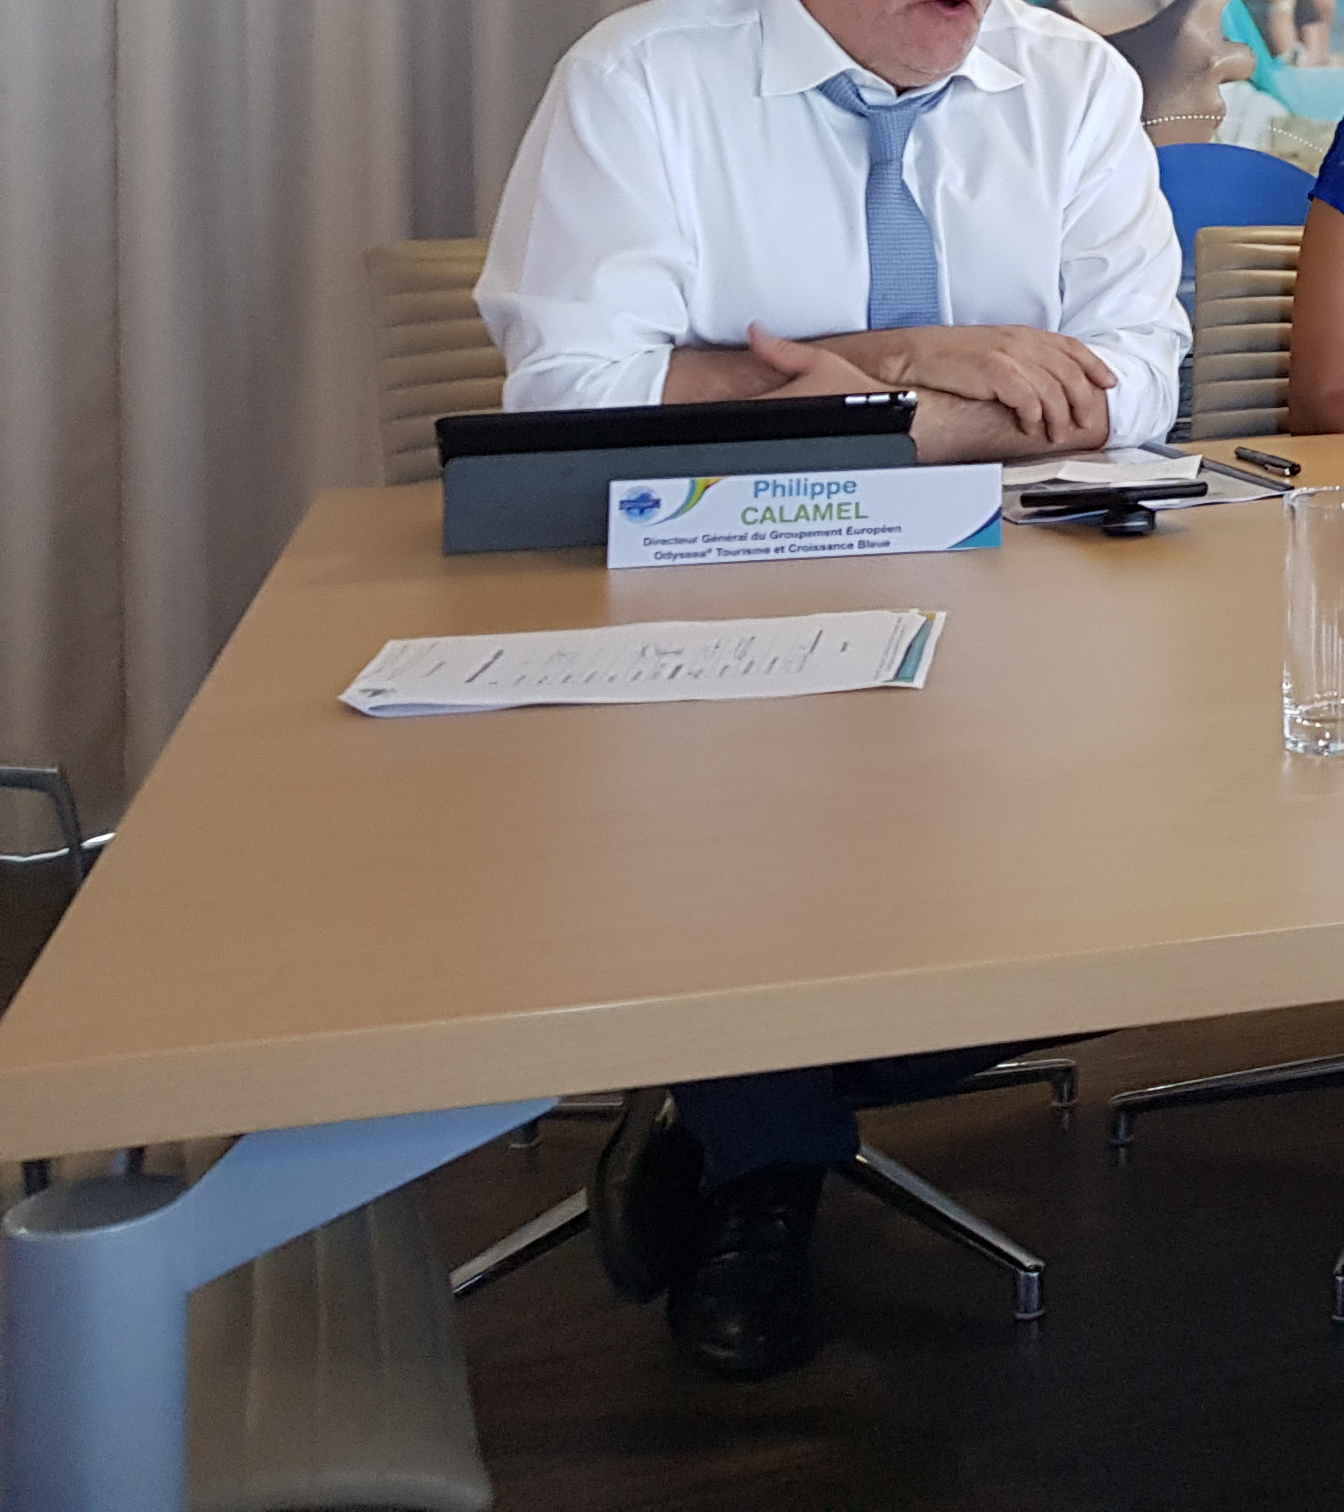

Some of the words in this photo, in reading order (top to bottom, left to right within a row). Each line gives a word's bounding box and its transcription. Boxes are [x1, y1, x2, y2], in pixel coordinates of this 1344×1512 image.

[753, 478, 858, 500] Philippe
[740, 501, 869, 526] CALAMEL
[751, 532, 766, 541] du
[769, 529, 842, 539] Groupement
[774, 545, 785, 553] et
[788, 542, 854, 553] Croissance
